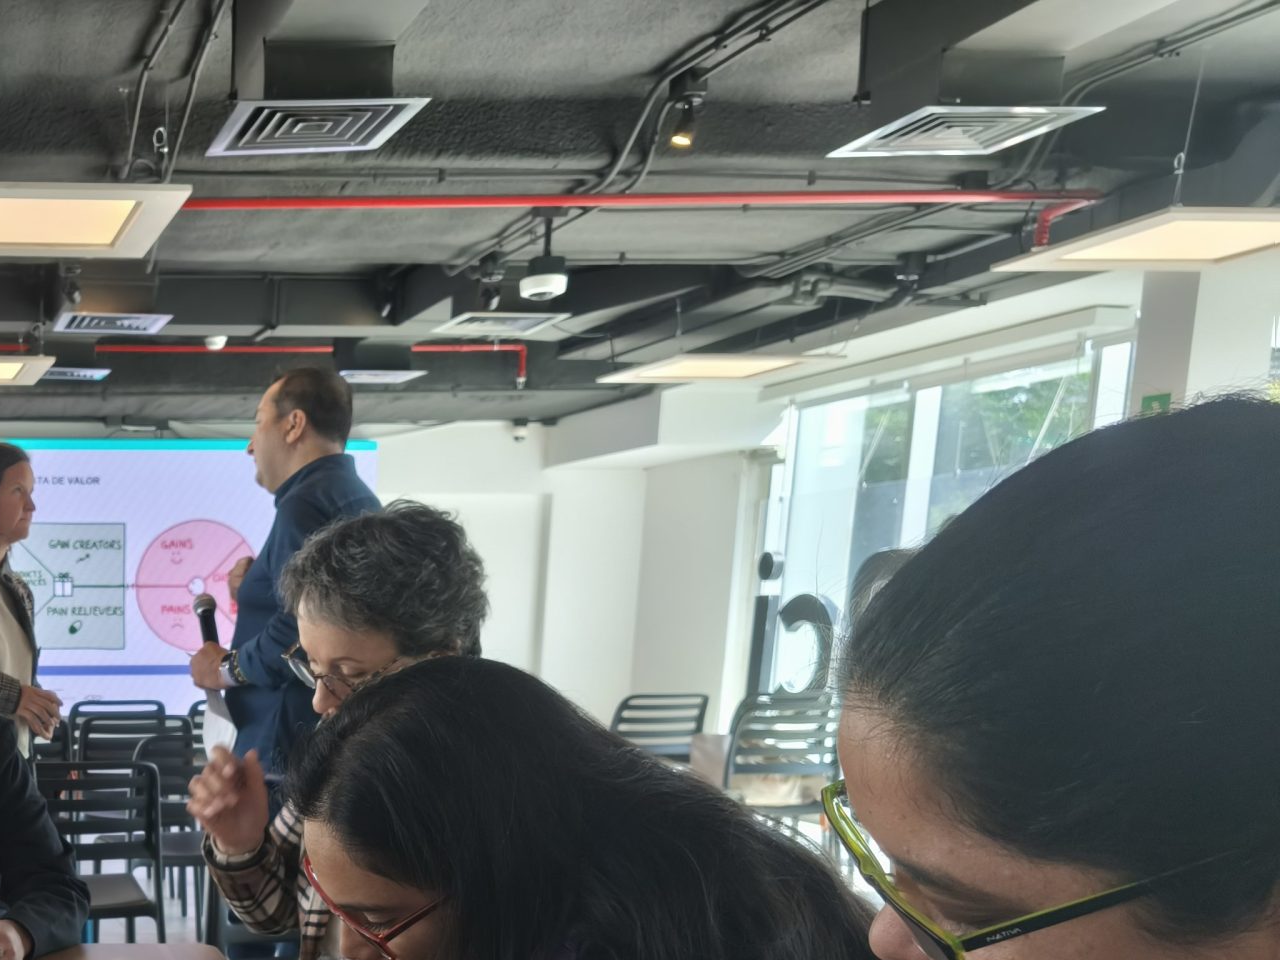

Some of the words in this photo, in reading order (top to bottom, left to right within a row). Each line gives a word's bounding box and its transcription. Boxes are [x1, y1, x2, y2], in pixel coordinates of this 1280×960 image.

[67, 477, 101, 486] VALOR
[73, 539, 122, 550] CREATORS
[160, 538, 193, 550] GAINS
[46, 606, 68, 617] PAIN
[70, 606, 124, 617] RELIEVERS
[160, 605, 192, 615] PAINS
